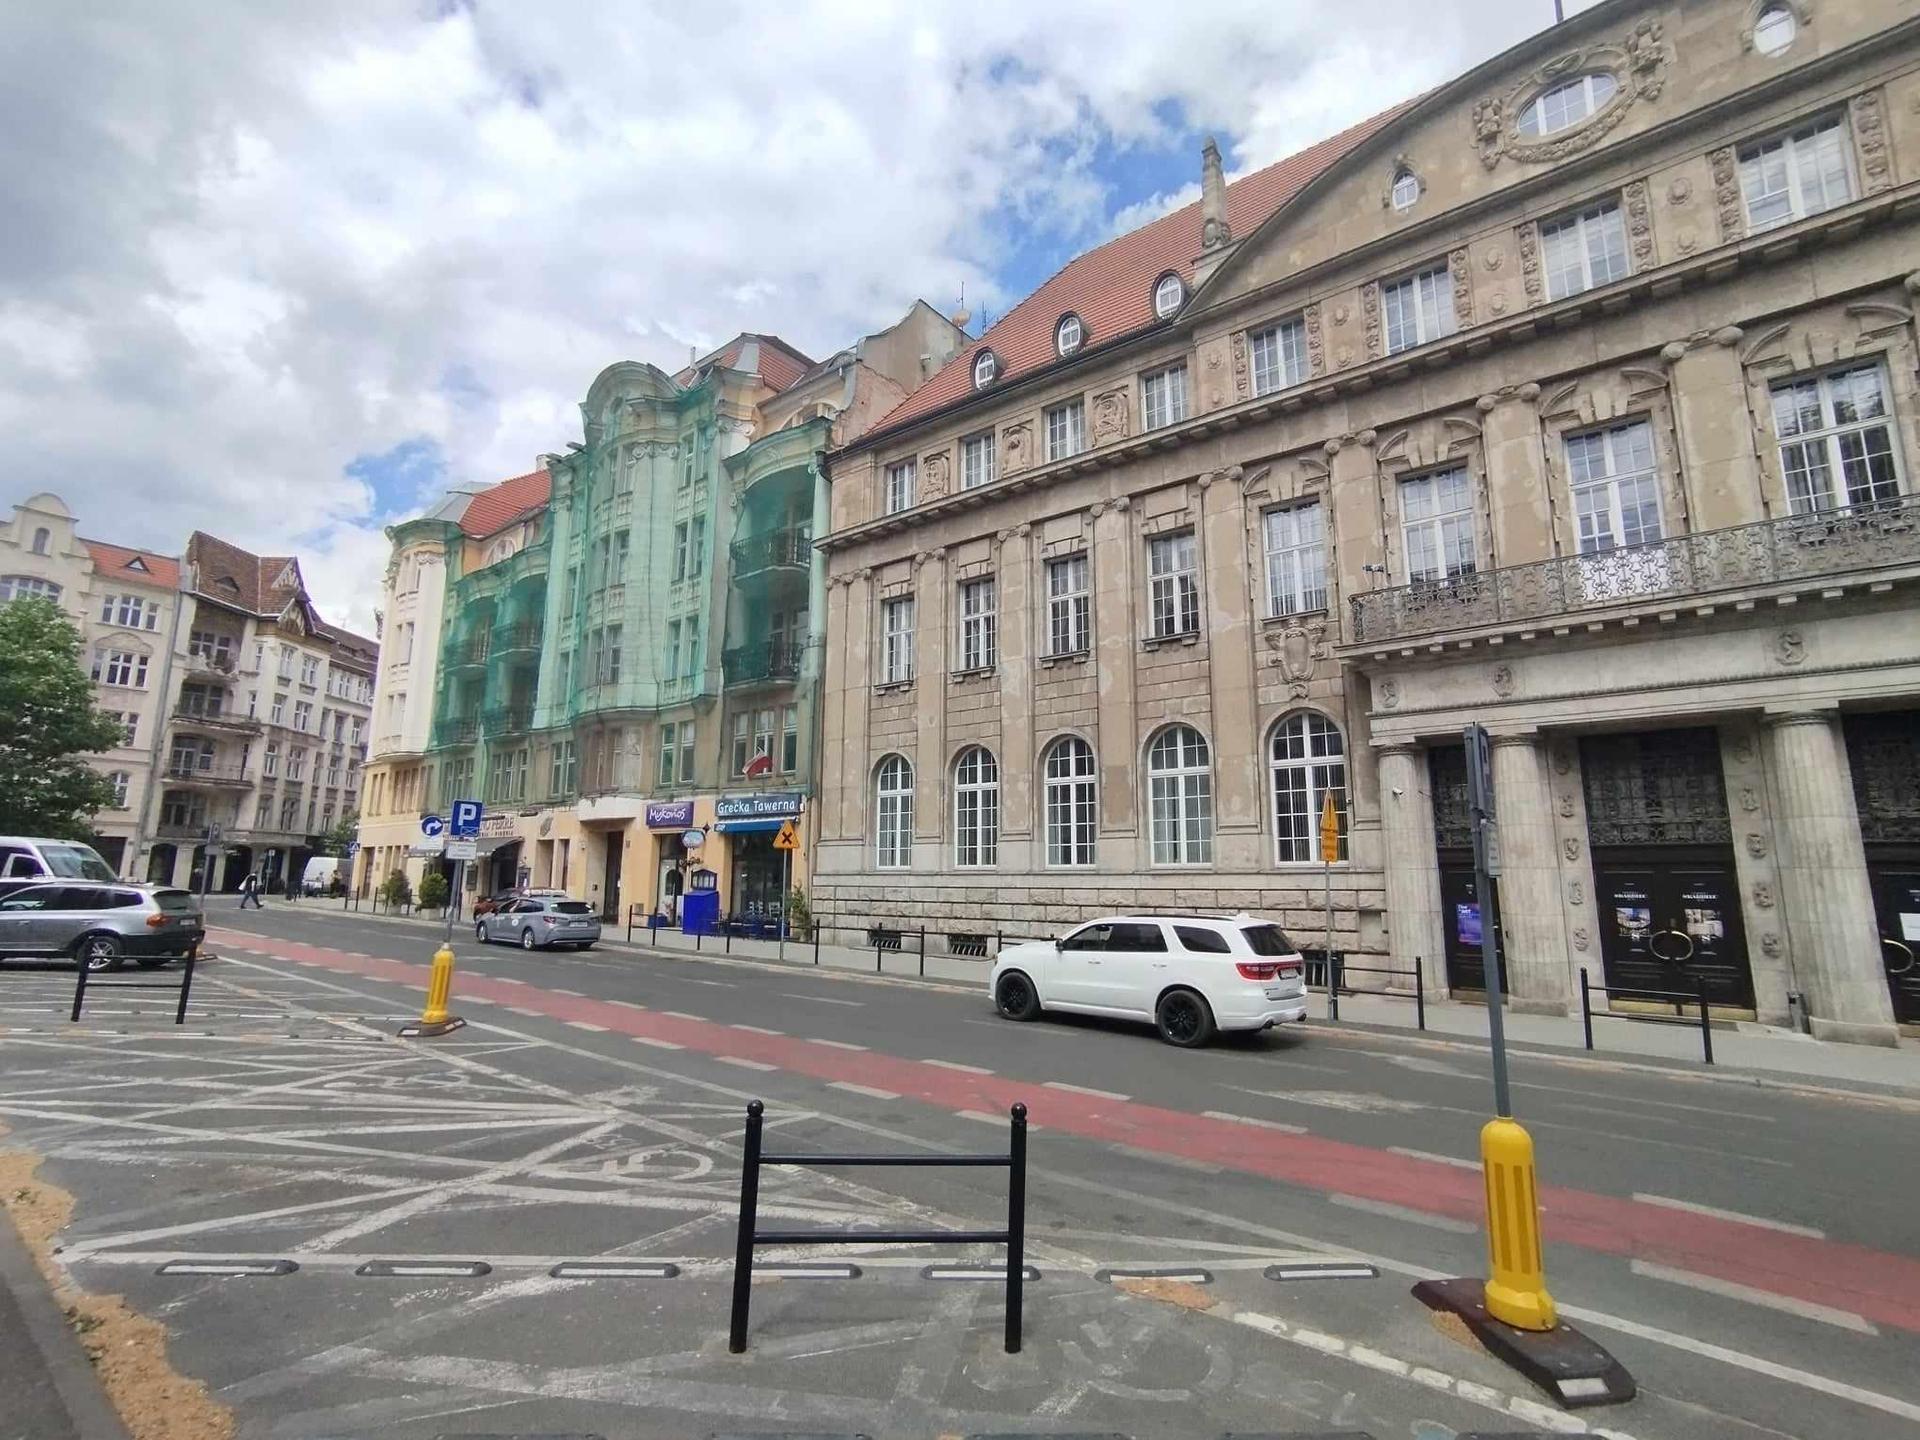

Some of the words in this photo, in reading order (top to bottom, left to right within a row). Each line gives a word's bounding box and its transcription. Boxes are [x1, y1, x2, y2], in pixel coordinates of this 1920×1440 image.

[458, 803, 477, 826] P
[717, 801, 750, 814] Grecka
[753, 799, 795, 812] Tawerna
